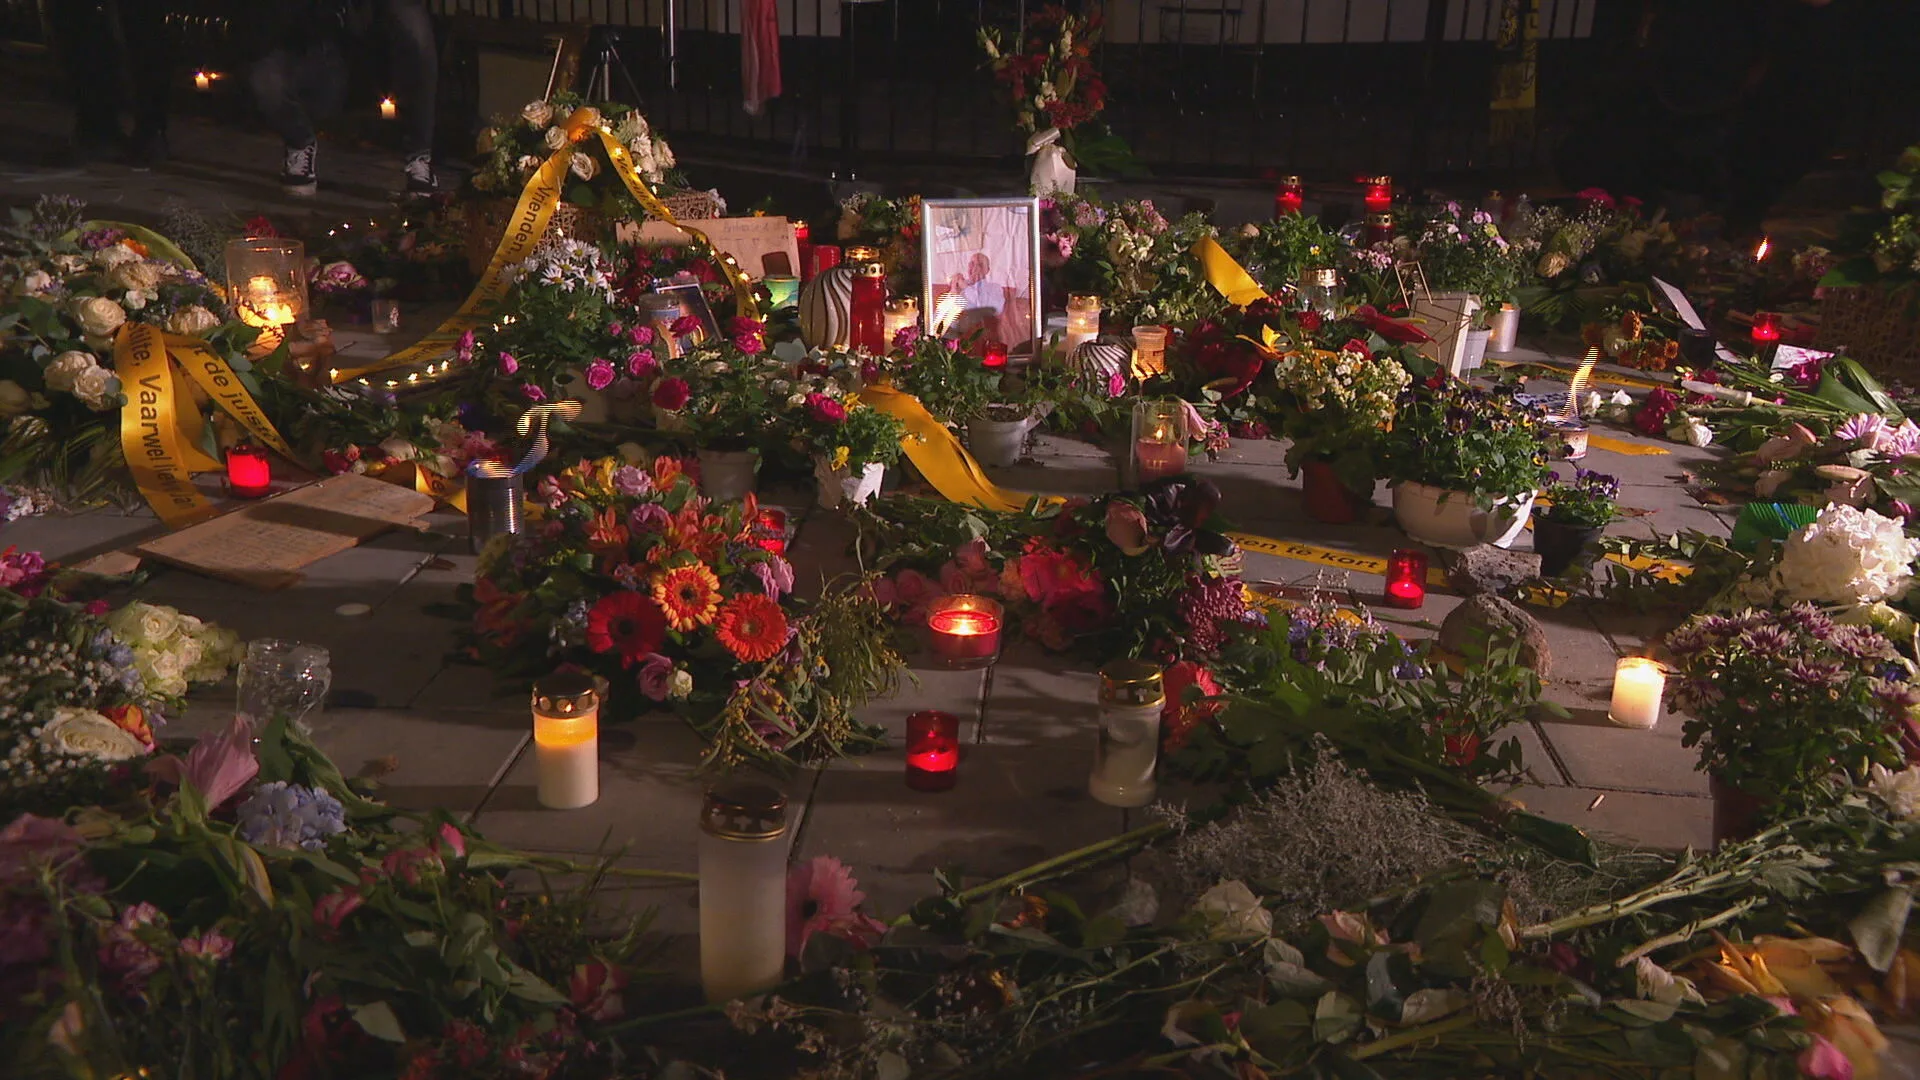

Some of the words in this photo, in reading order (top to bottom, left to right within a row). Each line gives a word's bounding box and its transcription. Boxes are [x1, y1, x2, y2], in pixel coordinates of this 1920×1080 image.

[507, 186, 553, 255] Vrienden,
[204, 362, 229, 388] de
[139, 374, 172, 462] Vaarwel
[1229, 534, 1277, 550] ten
[1286, 544, 1312, 556] te
[1321, 551, 1379, 569] kort
